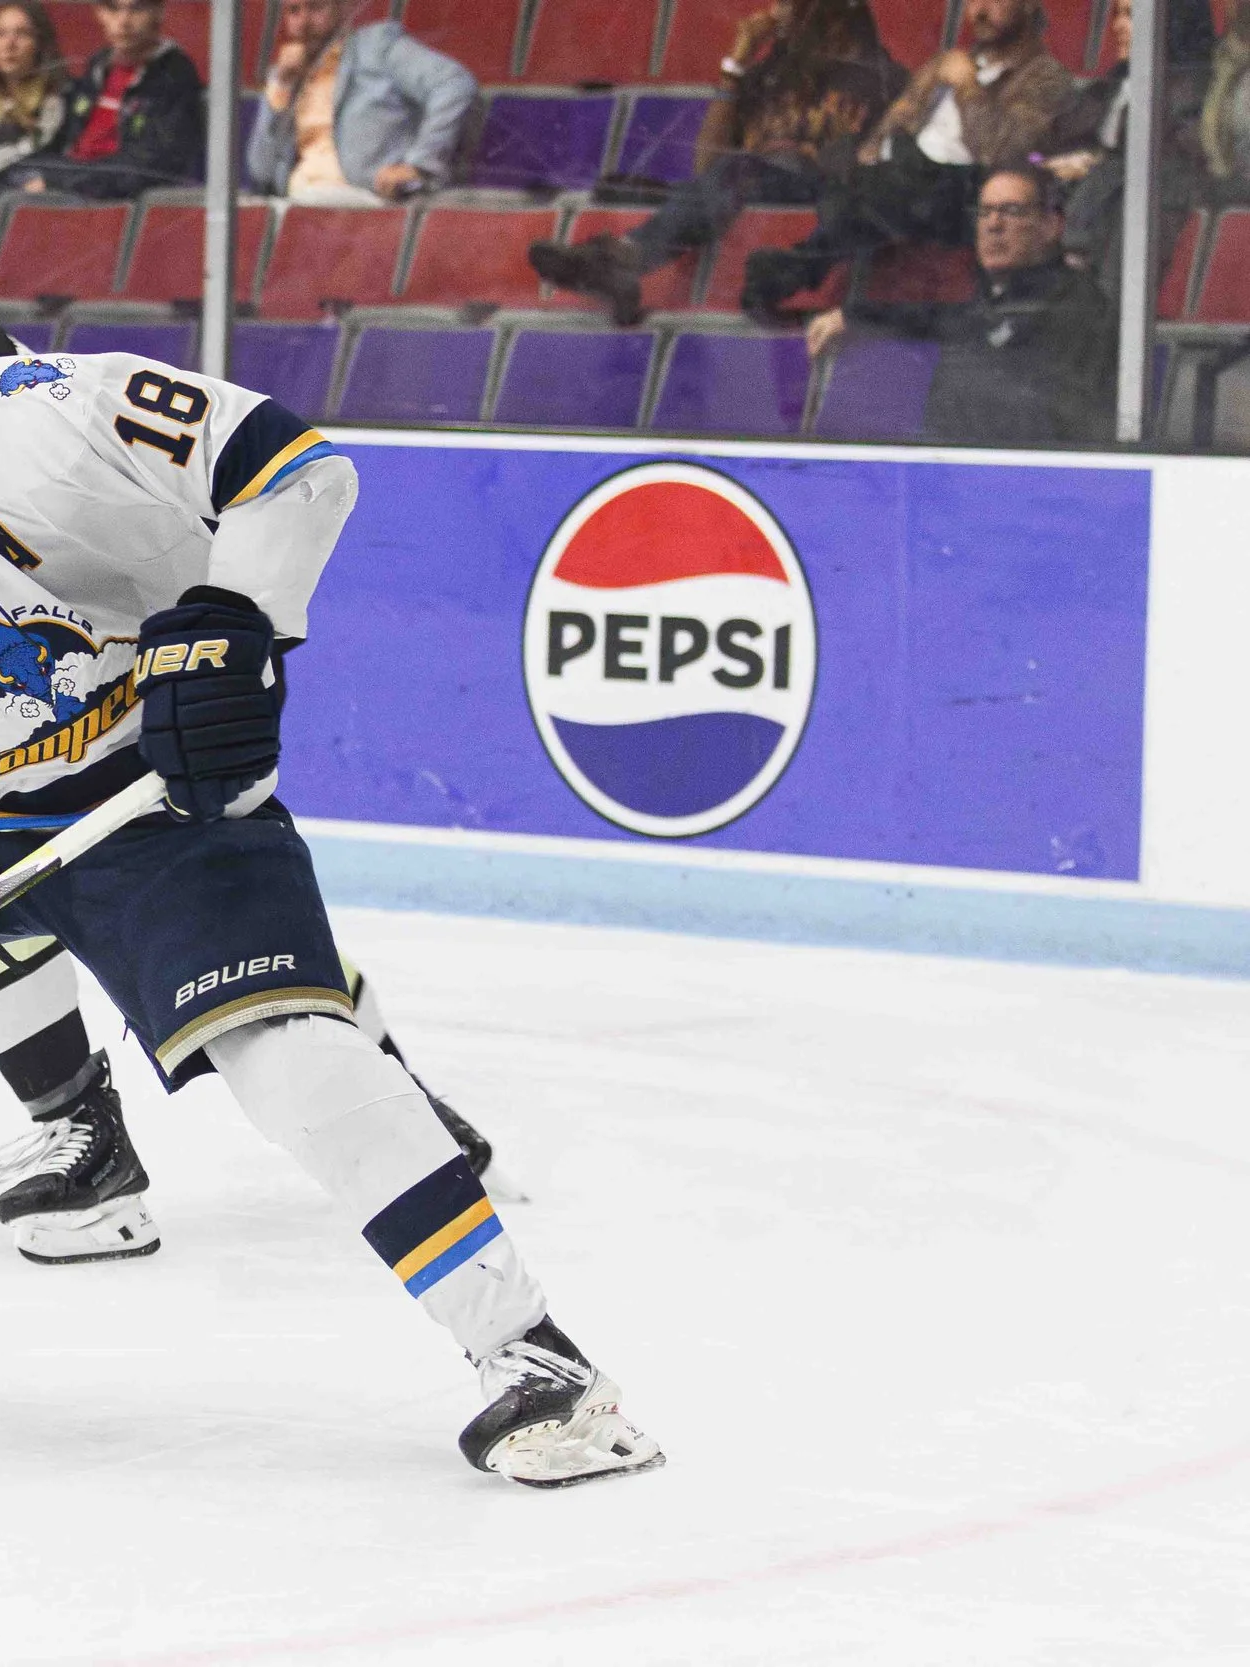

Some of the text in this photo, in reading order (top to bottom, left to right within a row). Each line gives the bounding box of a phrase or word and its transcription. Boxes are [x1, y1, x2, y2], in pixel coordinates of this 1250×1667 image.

[113, 369, 211, 469] 18
[547, 609, 793, 690] PEPSI
[174, 953, 297, 1010] BAUER
